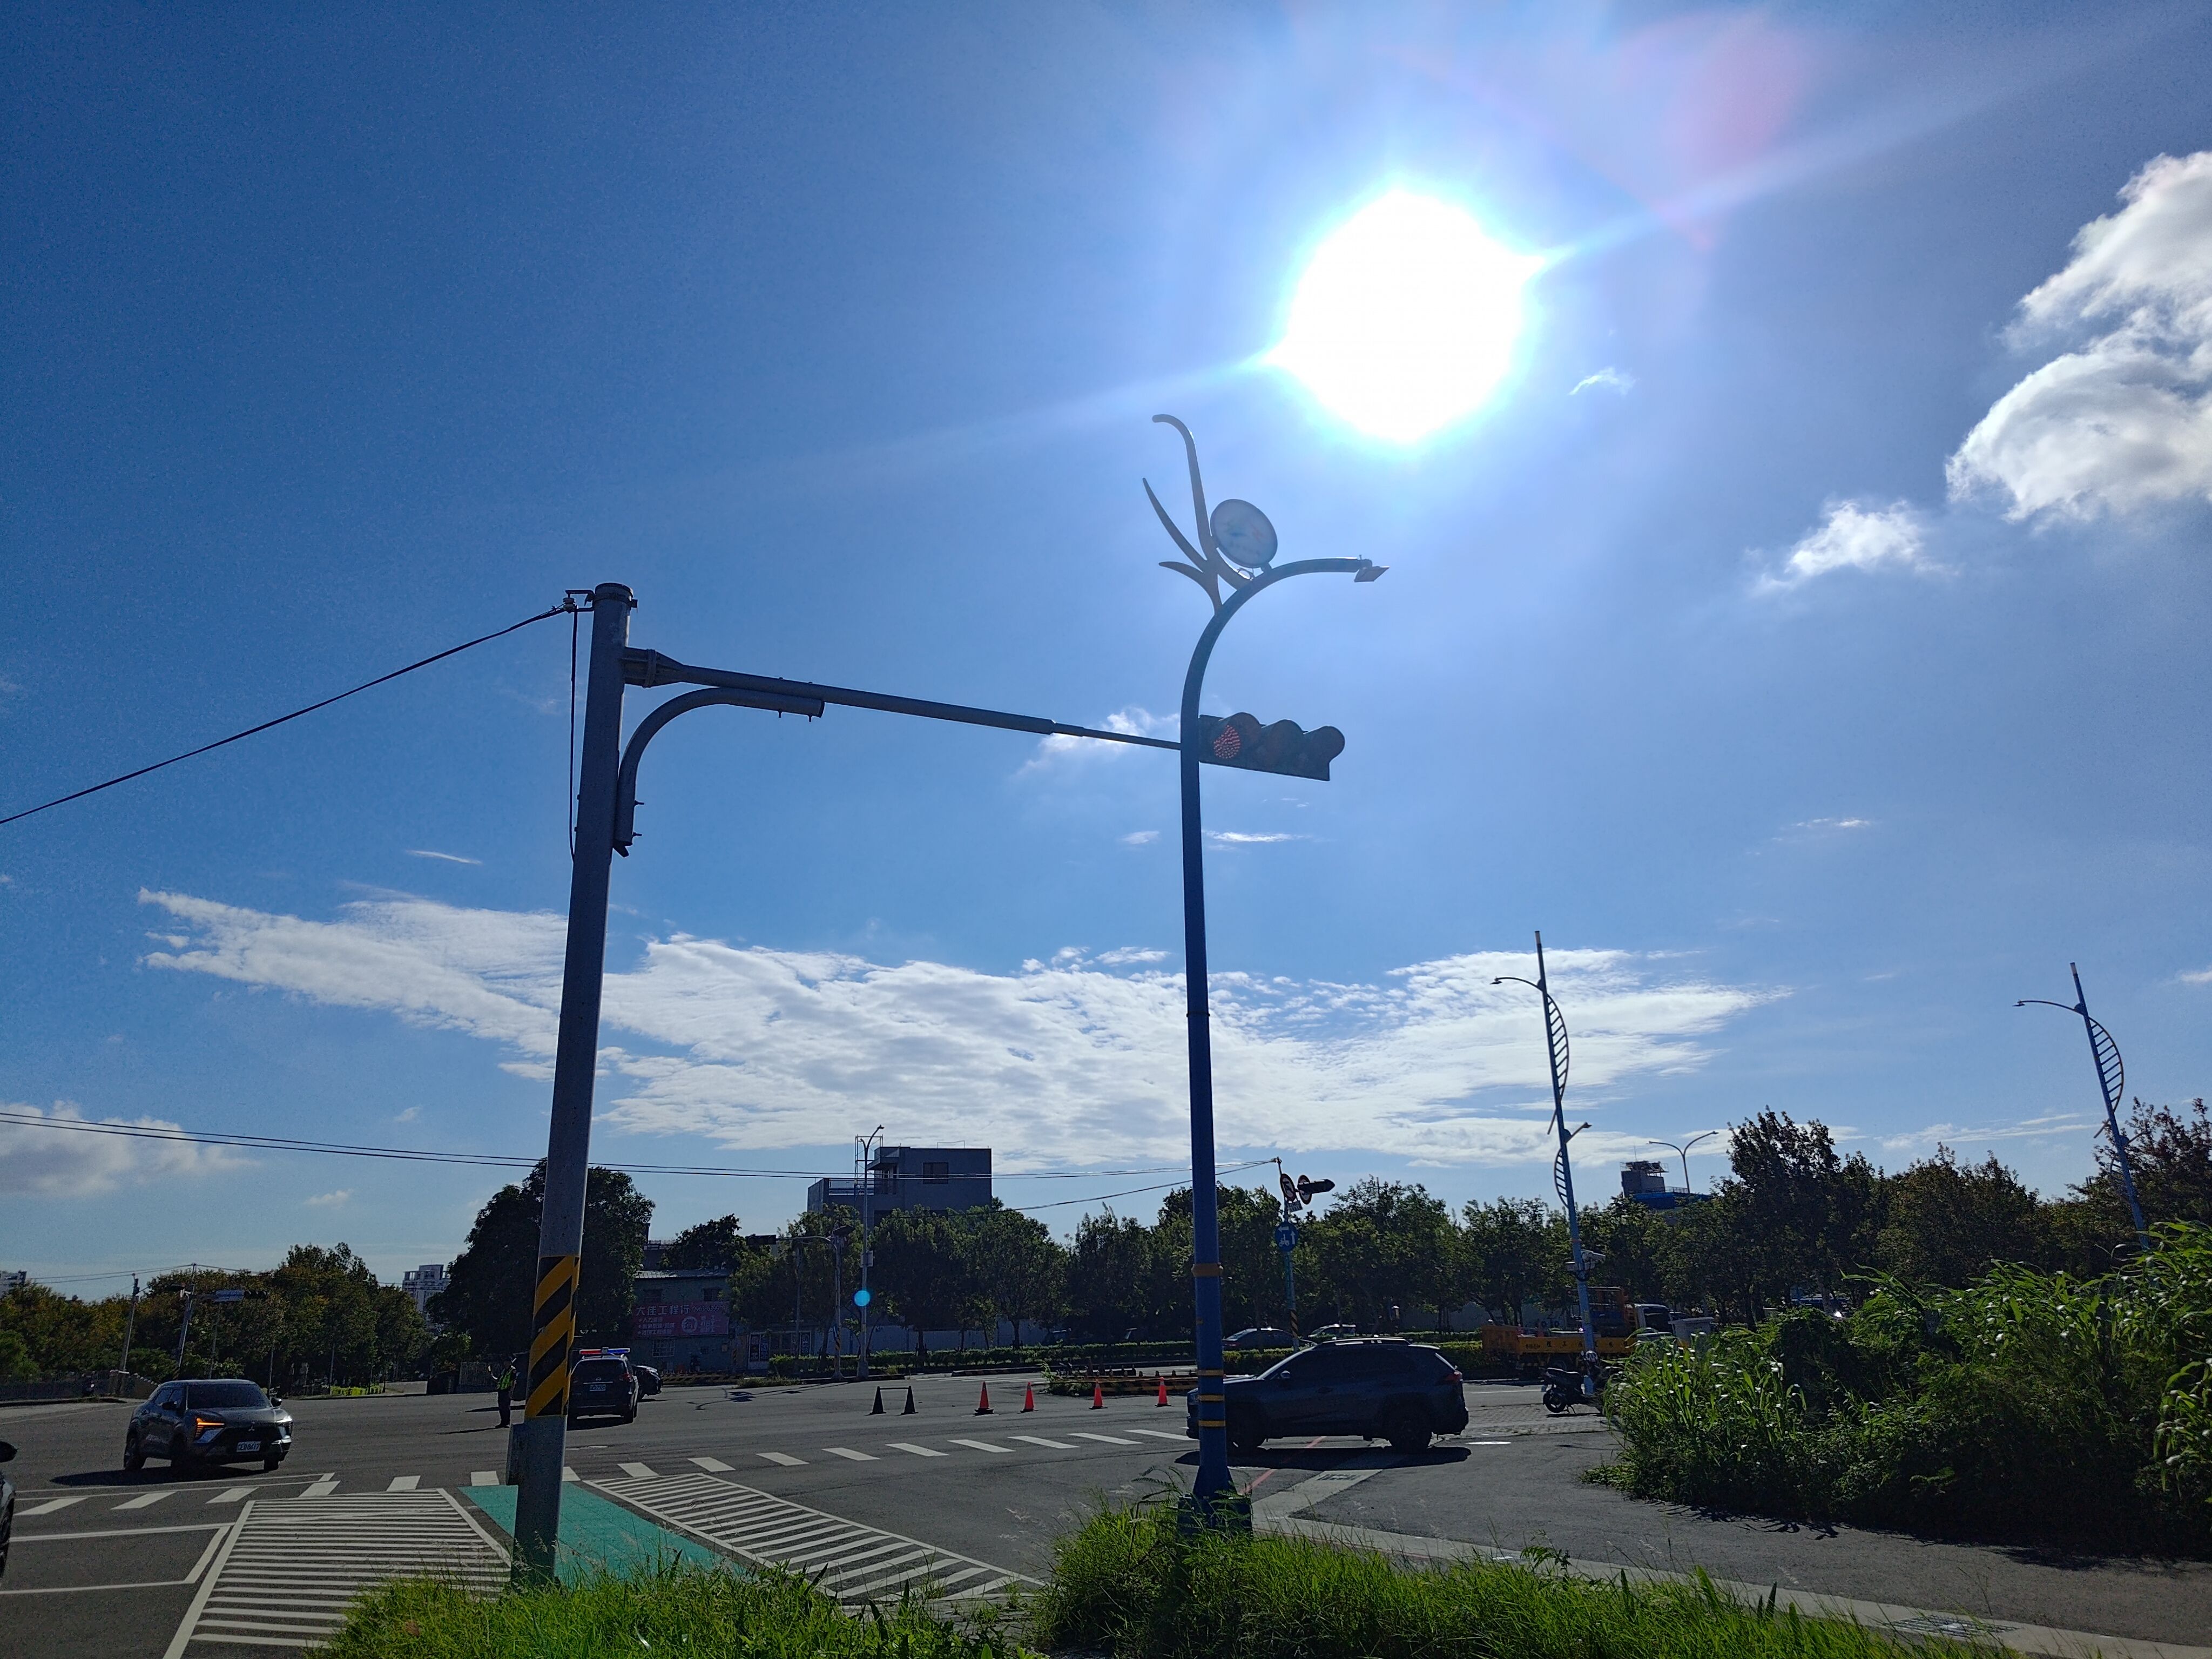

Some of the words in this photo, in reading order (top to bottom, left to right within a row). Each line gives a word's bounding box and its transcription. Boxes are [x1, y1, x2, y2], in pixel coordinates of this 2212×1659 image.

[636, 1305, 690, 1316] 大佳工程行
